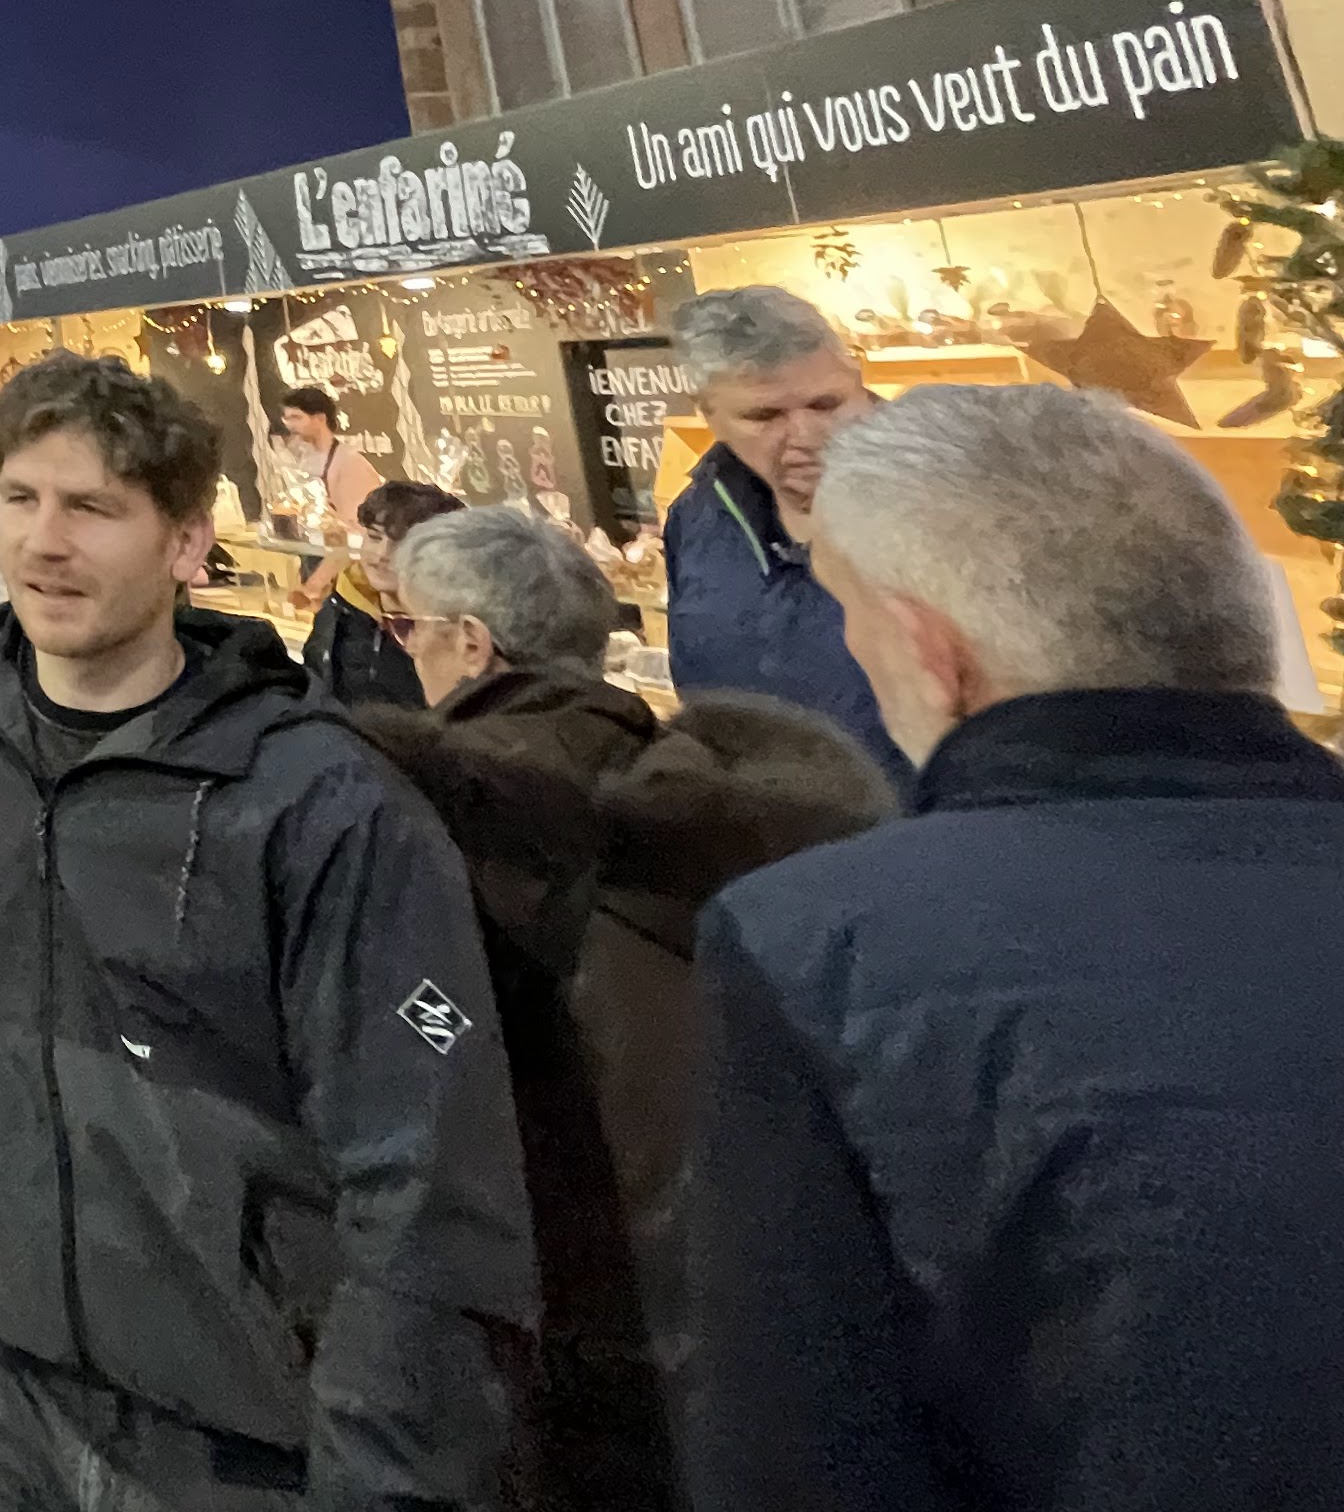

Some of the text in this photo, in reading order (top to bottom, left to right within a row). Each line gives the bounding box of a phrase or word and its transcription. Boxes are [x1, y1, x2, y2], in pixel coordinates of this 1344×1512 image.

[626, 0, 1239, 190] Un ami qui vous veut du pain
[293, 131, 531, 252] L'enfariné
